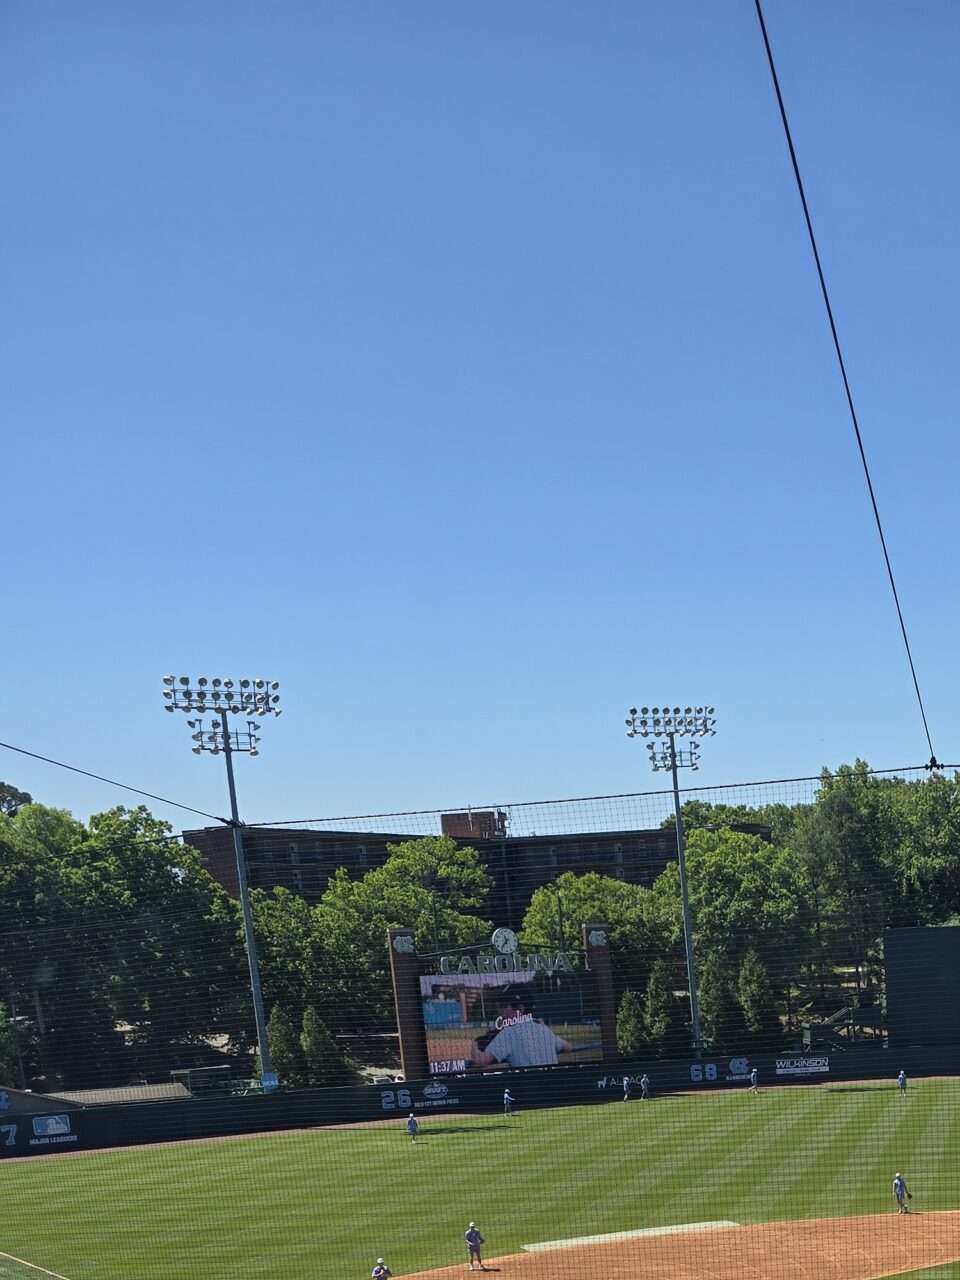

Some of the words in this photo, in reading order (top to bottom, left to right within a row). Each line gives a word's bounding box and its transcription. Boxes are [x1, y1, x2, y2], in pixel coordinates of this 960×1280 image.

[440, 953, 573, 974] CAROLINA
[495, 1010, 535, 1030] Carolina
[430, 1062, 450, 1073] 11:37
[452, 1060, 465, 1071] AM
[381, 1089, 412, 1109] 26
